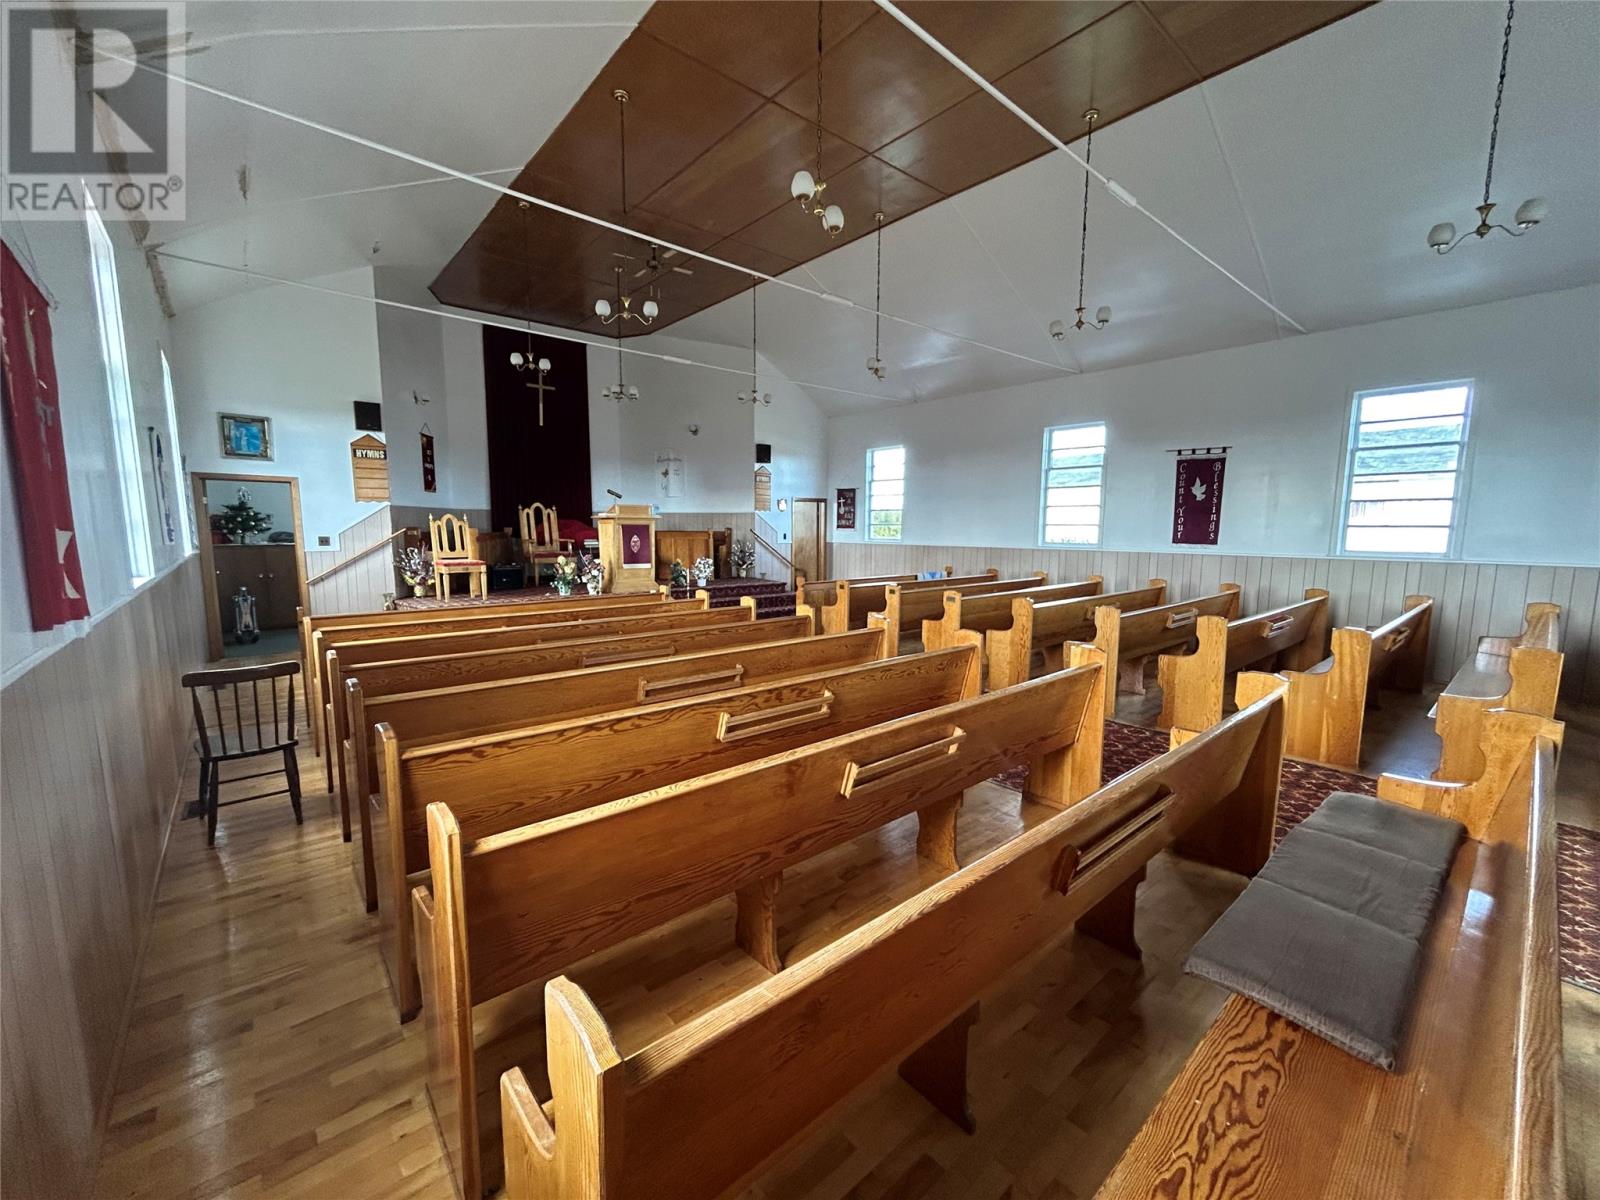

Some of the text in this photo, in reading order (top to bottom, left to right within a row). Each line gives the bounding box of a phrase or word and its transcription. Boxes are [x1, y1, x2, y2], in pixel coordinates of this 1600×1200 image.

[355, 449, 385, 459] HYMNS
[1177, 463, 1187, 538] Count Your
[1209, 461, 1221, 540] Blessings
